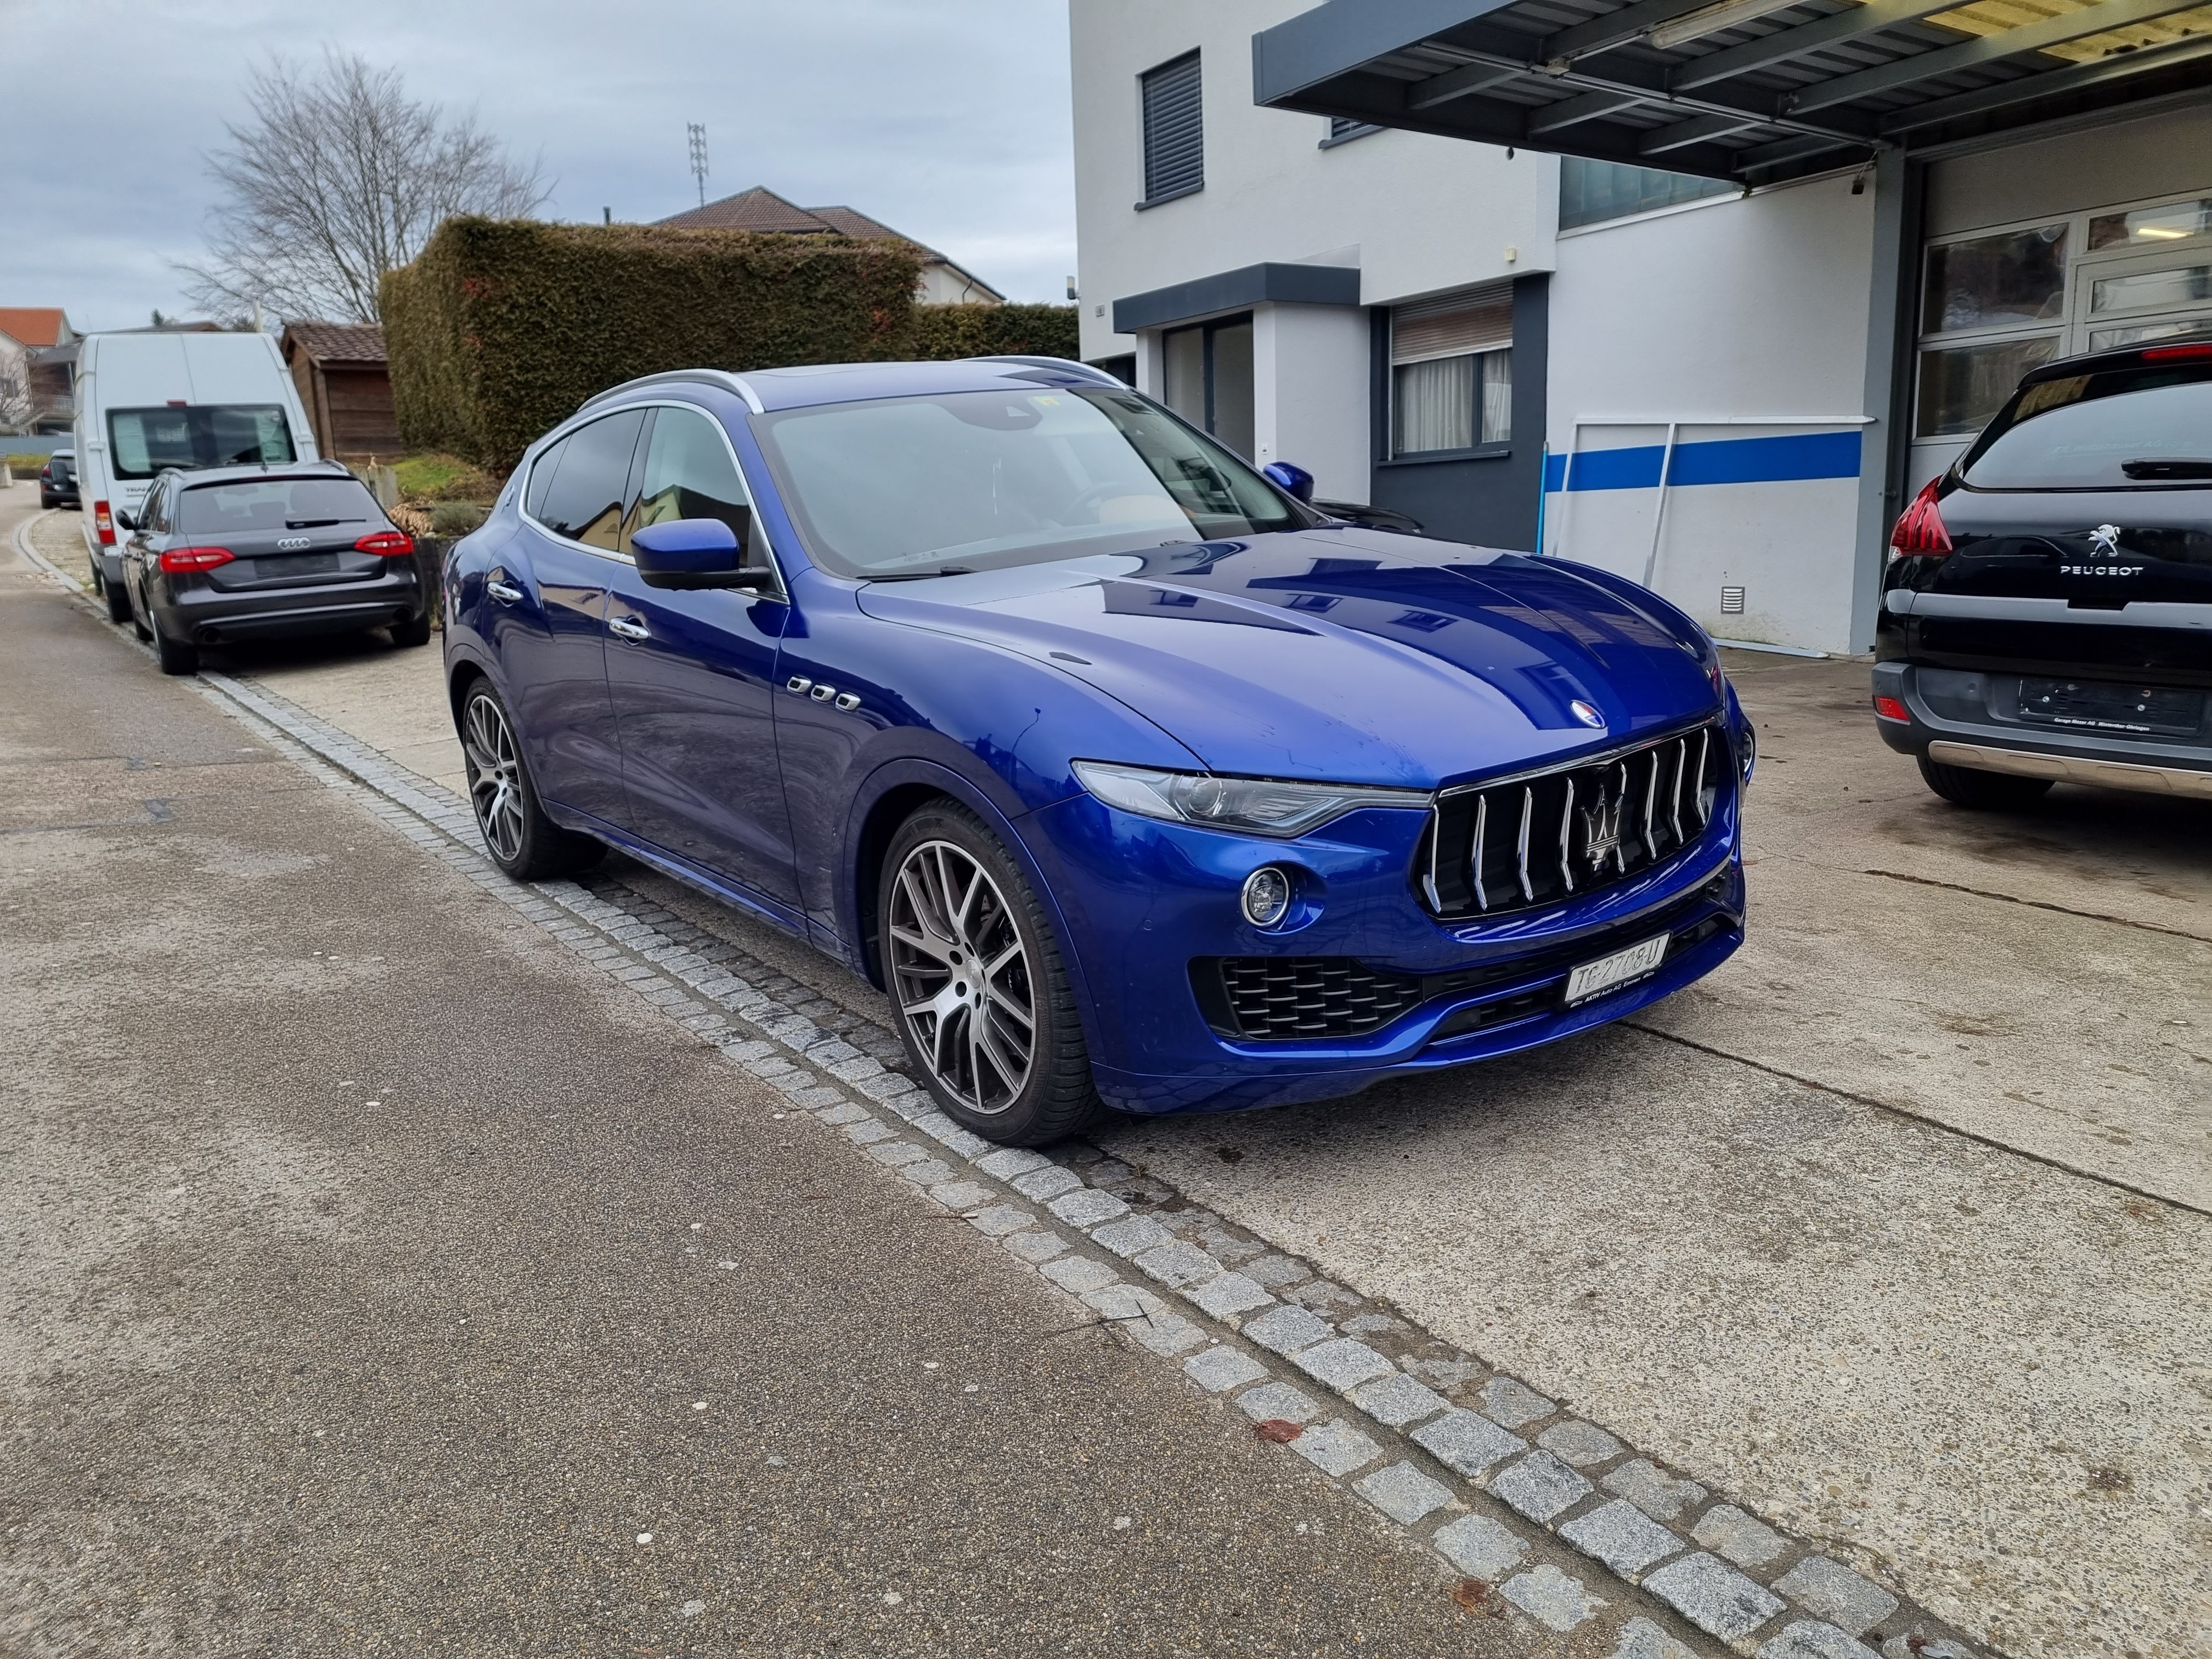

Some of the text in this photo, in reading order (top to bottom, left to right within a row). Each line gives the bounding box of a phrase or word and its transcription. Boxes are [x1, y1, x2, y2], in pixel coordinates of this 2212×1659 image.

[2060, 566, 2144, 575] PEUGEOT
[1584, 991, 1601, 1003] AKTIV
[1600, 988, 1613, 997] Auto
[1613, 983, 1622, 991] AG
